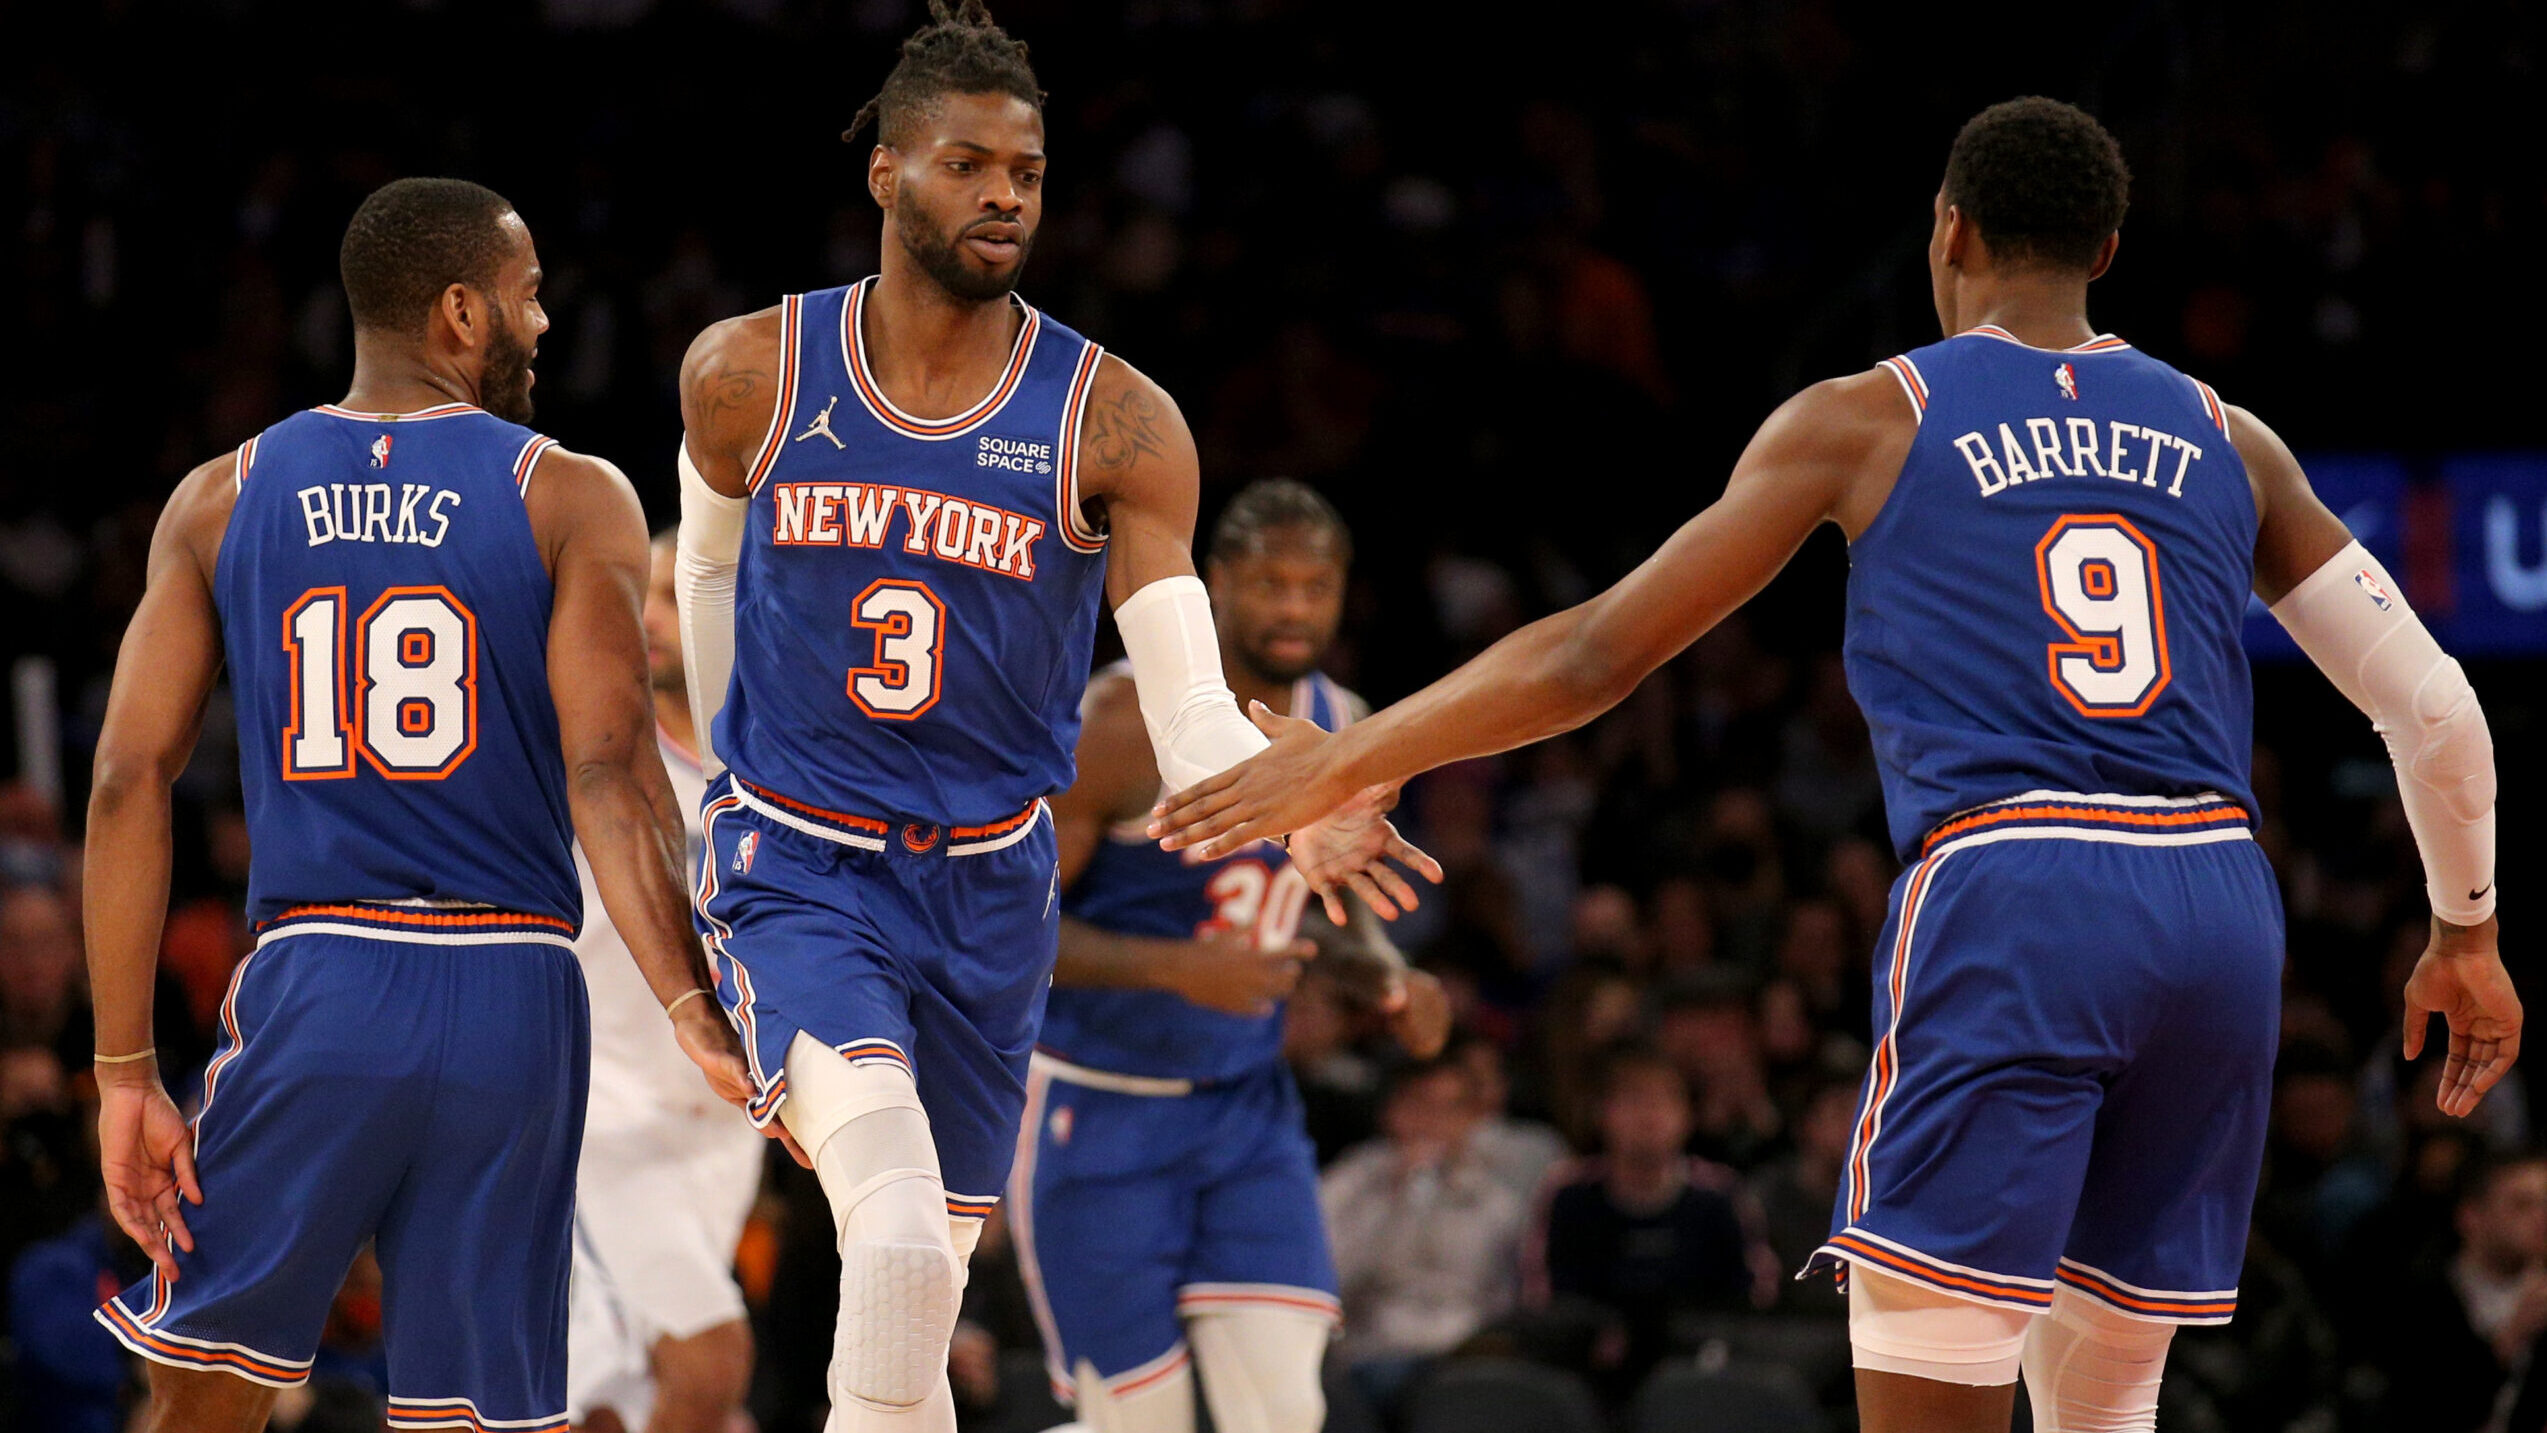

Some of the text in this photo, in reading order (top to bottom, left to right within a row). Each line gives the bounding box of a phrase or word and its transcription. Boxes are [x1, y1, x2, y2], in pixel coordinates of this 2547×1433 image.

[976, 452, 1035, 473] SPACE
[978, 436, 1051, 460] SQUARE
[1953, 416, 2203, 499] BARRETT
[297, 483, 462, 548] BURKS
[773, 482, 1047, 582] NEW YORK
[846, 577, 947, 722] 3
[2034, 513, 2173, 718] 9
[282, 584, 478, 781] 18
